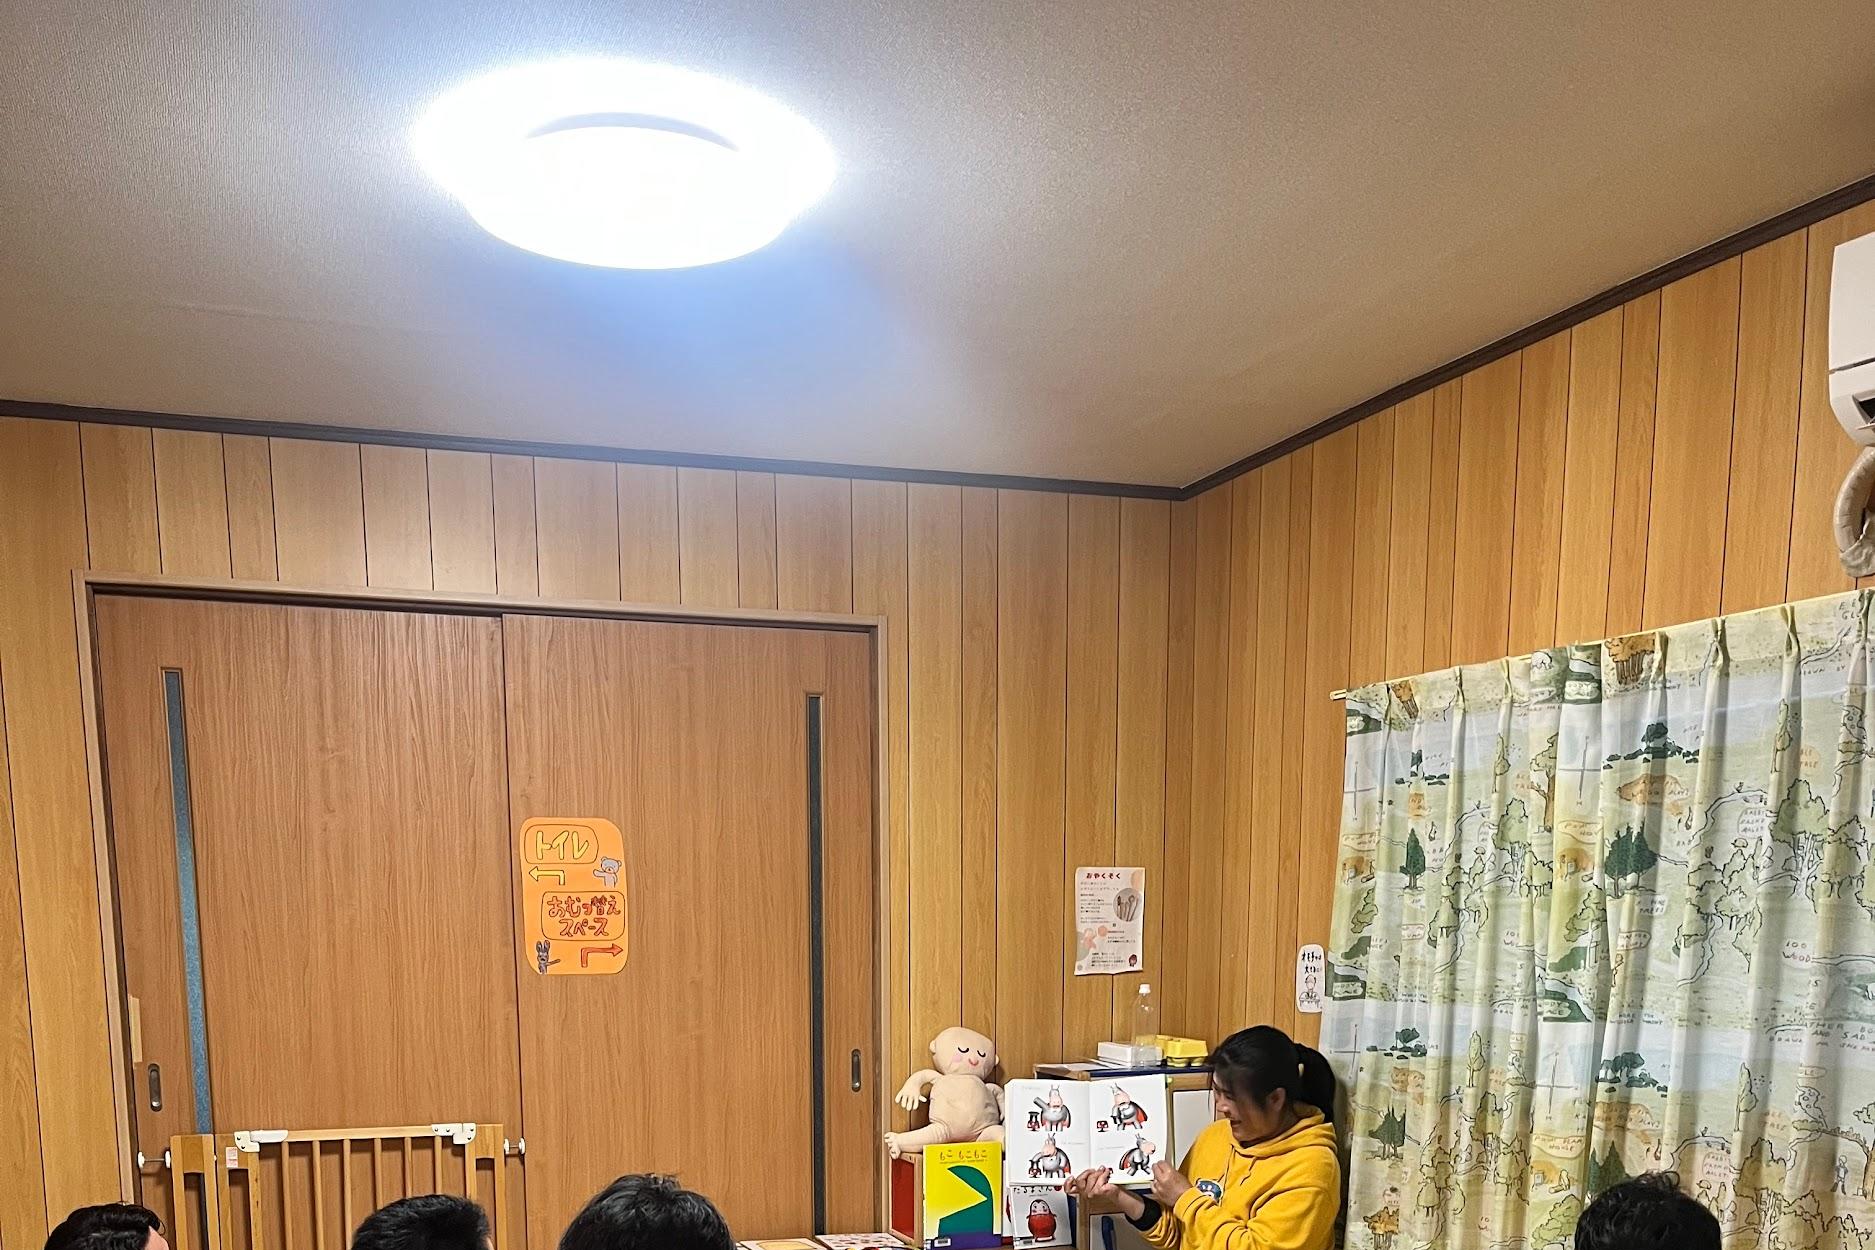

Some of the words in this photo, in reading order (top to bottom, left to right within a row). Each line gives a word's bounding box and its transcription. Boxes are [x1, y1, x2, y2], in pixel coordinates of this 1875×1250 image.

[535, 830, 590, 861] トイレ
[558, 917, 610, 937] スペース
[1786, 941, 1807, 949] 100
[1782, 951, 1811, 963] WOOD
